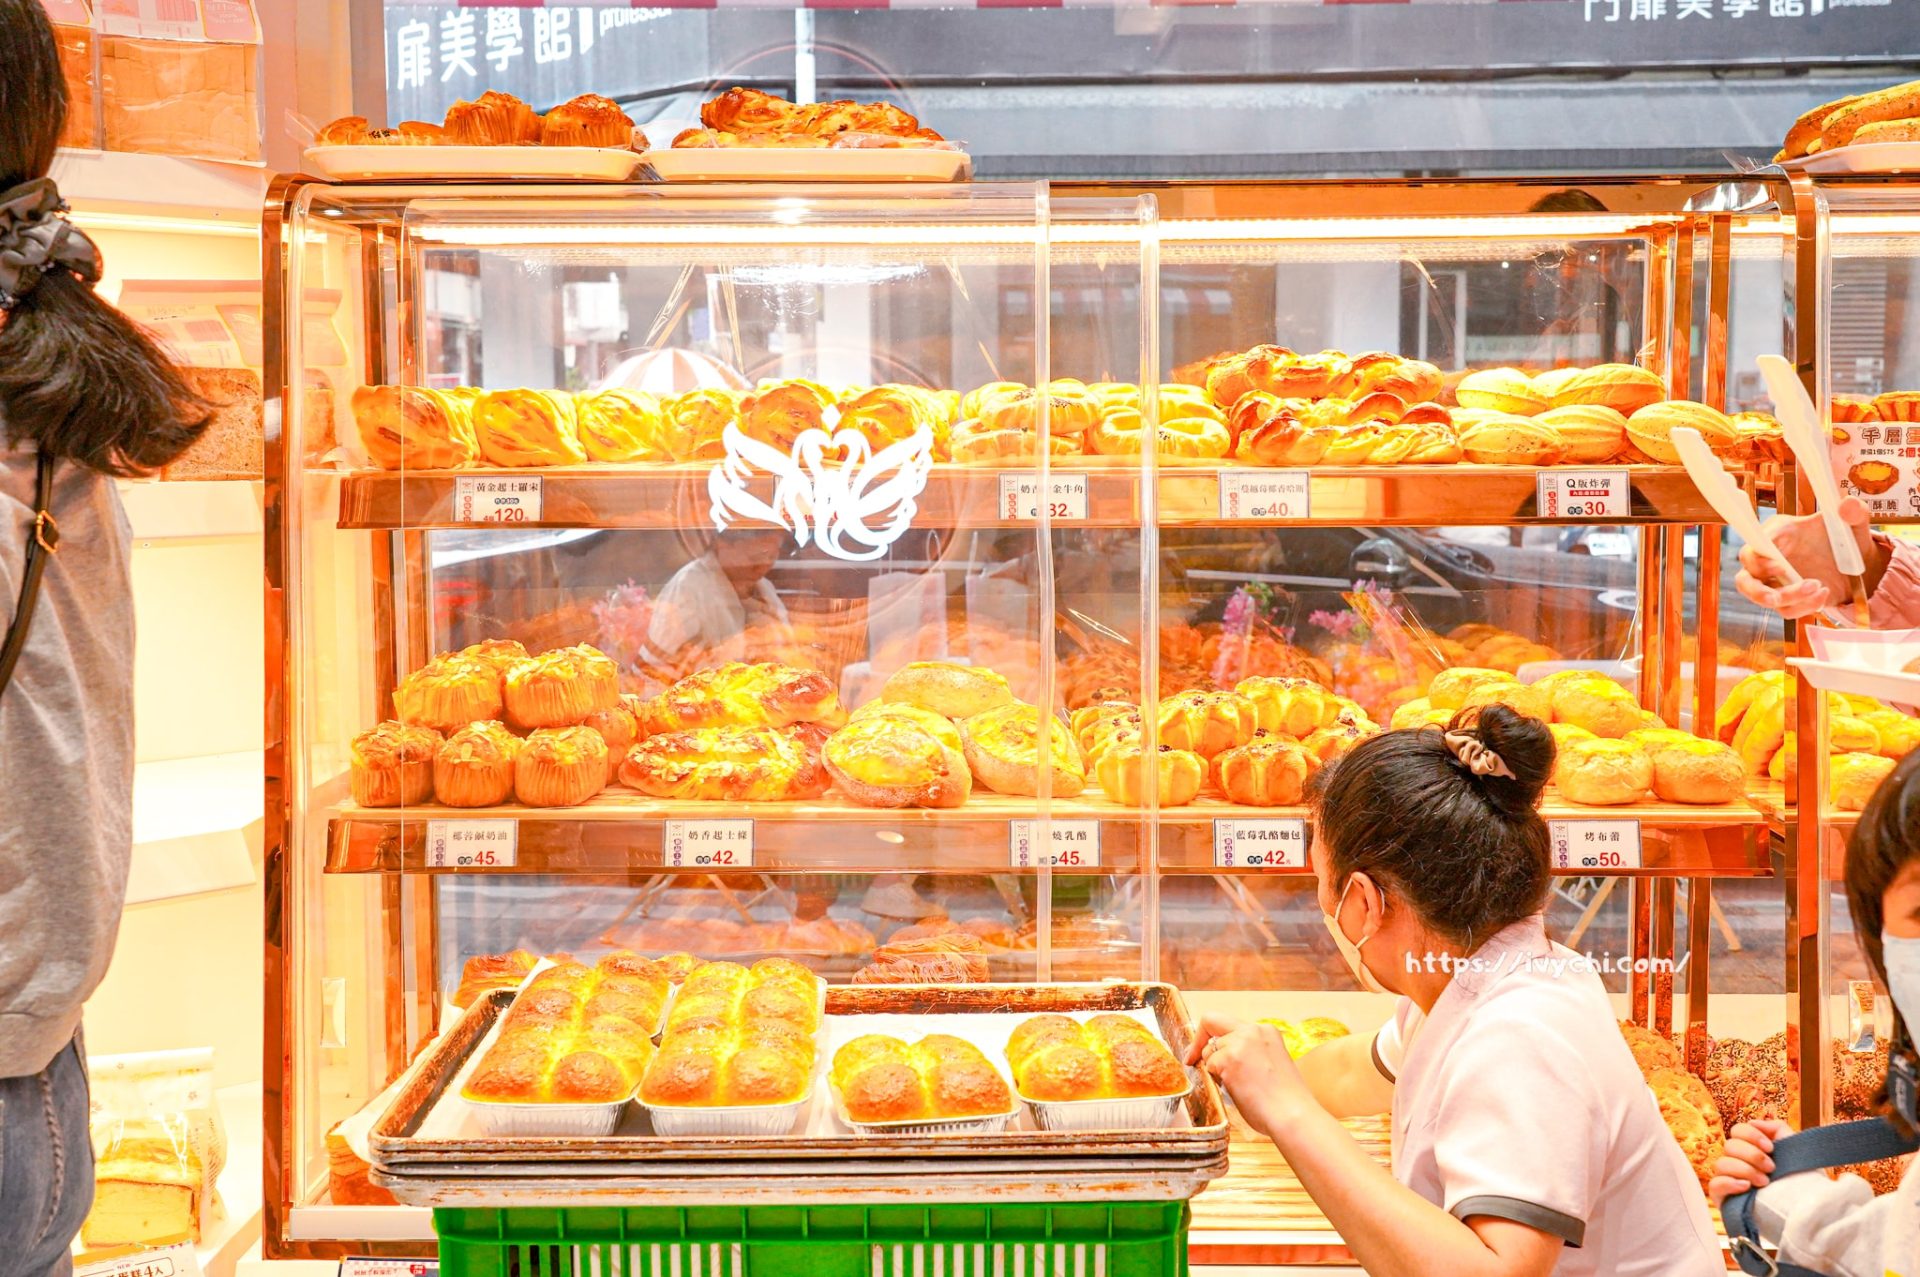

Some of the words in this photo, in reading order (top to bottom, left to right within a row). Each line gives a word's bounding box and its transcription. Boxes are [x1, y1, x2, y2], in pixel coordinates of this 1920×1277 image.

[385, 7, 571, 89] 扉美學館
[1566, 478, 1611, 488] Q版炸彈
[1871, 500, 1897, 510] 酥脆
[1050, 830, 1087, 840] 燒乳酪
[1585, 832, 1620, 841] 烤布蕾
